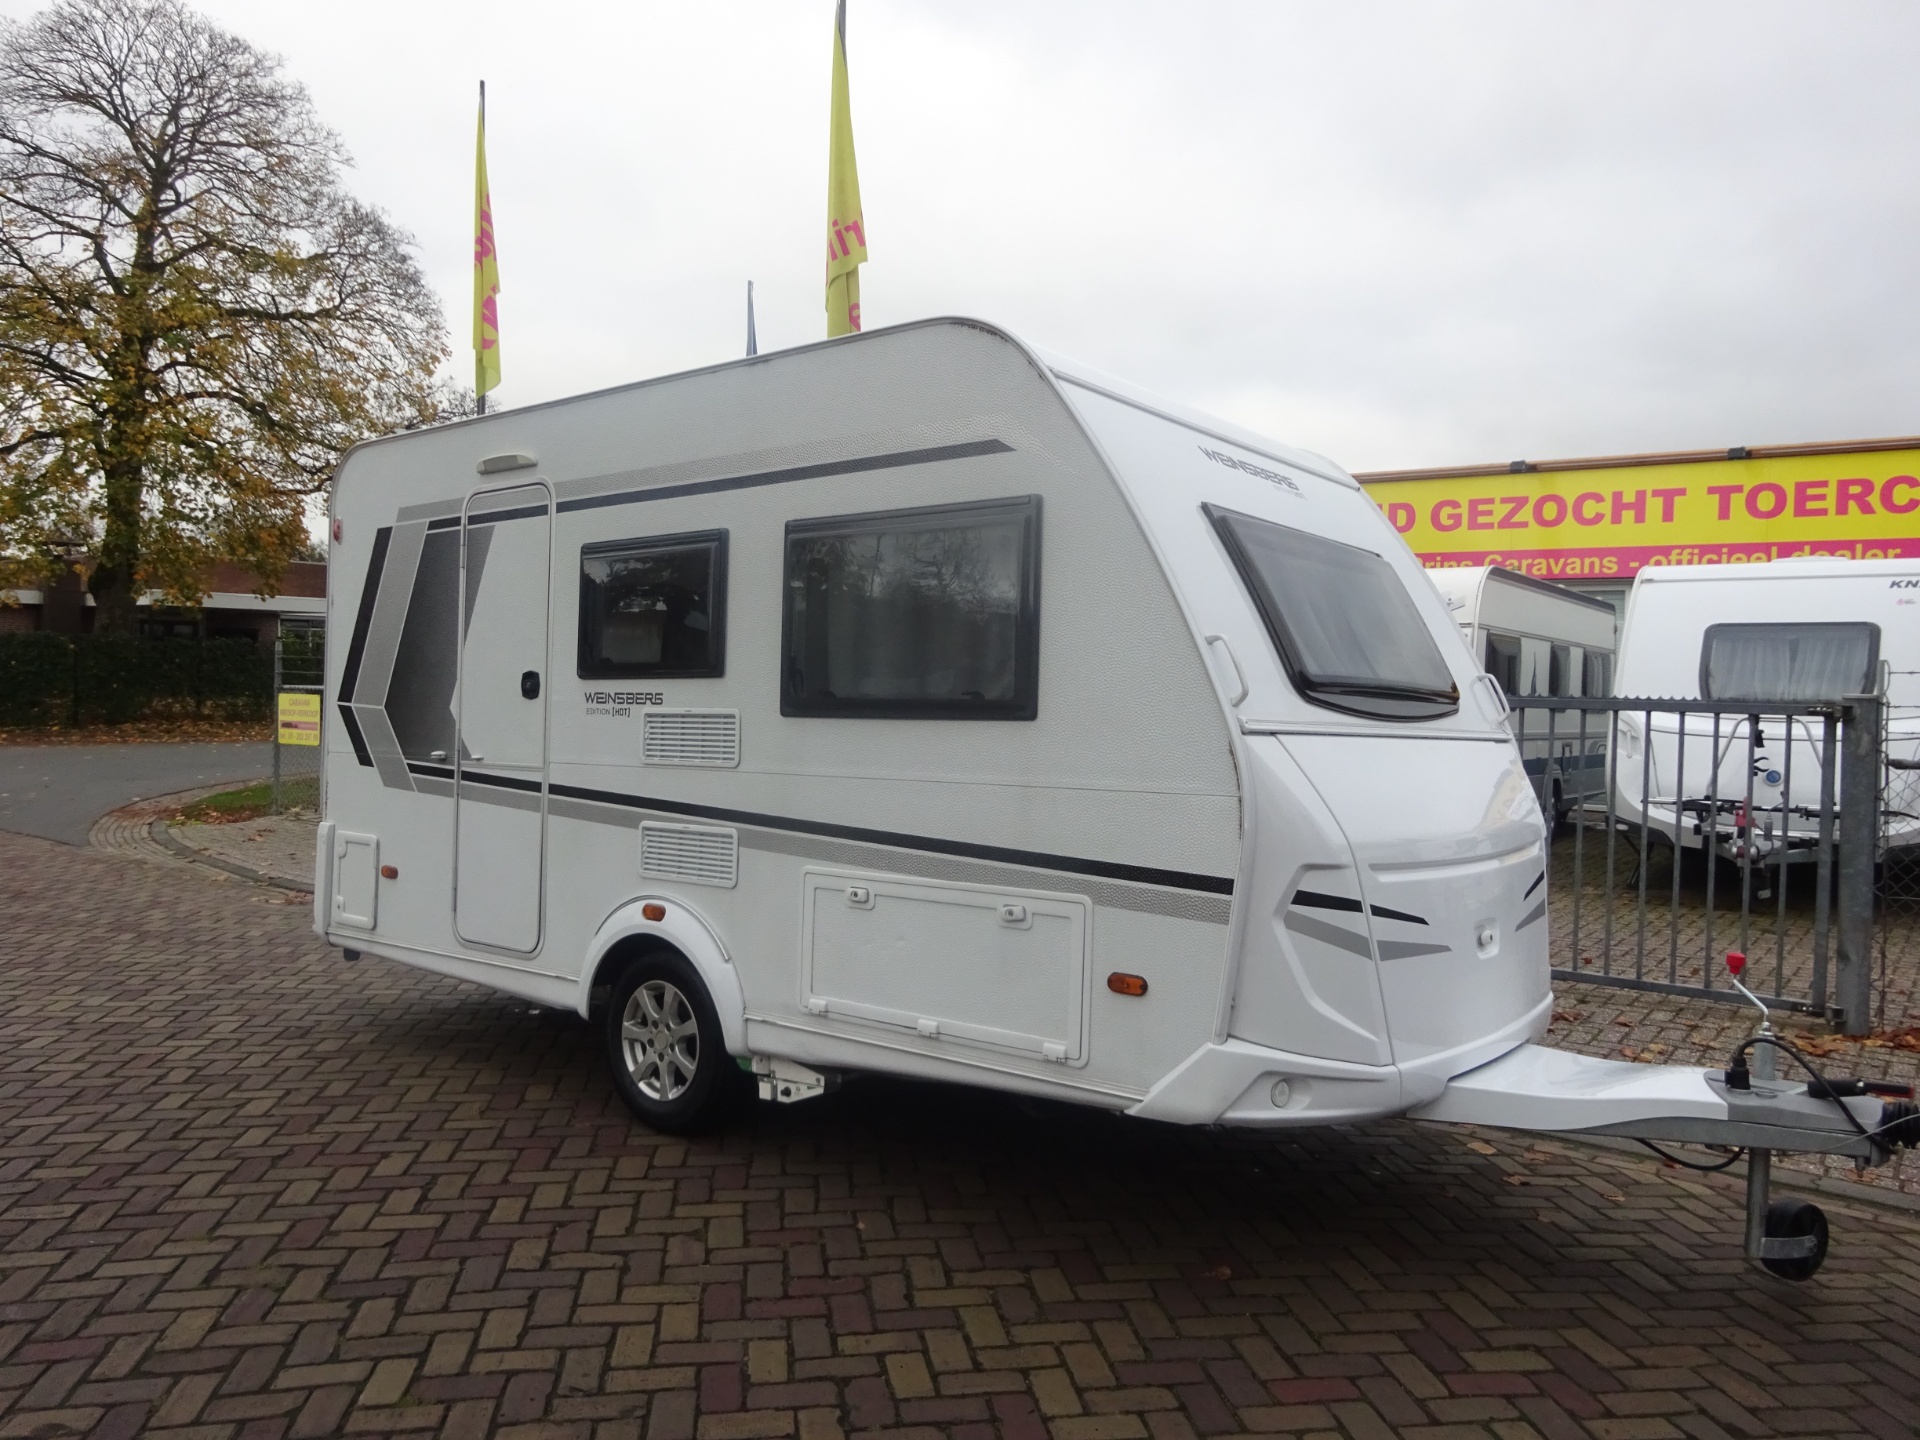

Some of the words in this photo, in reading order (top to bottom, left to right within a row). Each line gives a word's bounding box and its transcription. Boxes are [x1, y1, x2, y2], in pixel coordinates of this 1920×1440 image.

[1198, 445, 1299, 491] WEINSBERG
[1430, 487, 1687, 532] GEZOCHT
[1707, 475, 1920, 520] TOERC
[1889, 580, 1920, 588] KN
[584, 692, 664, 705] WEINSBERG
[586, 707, 610, 715] EDITION
